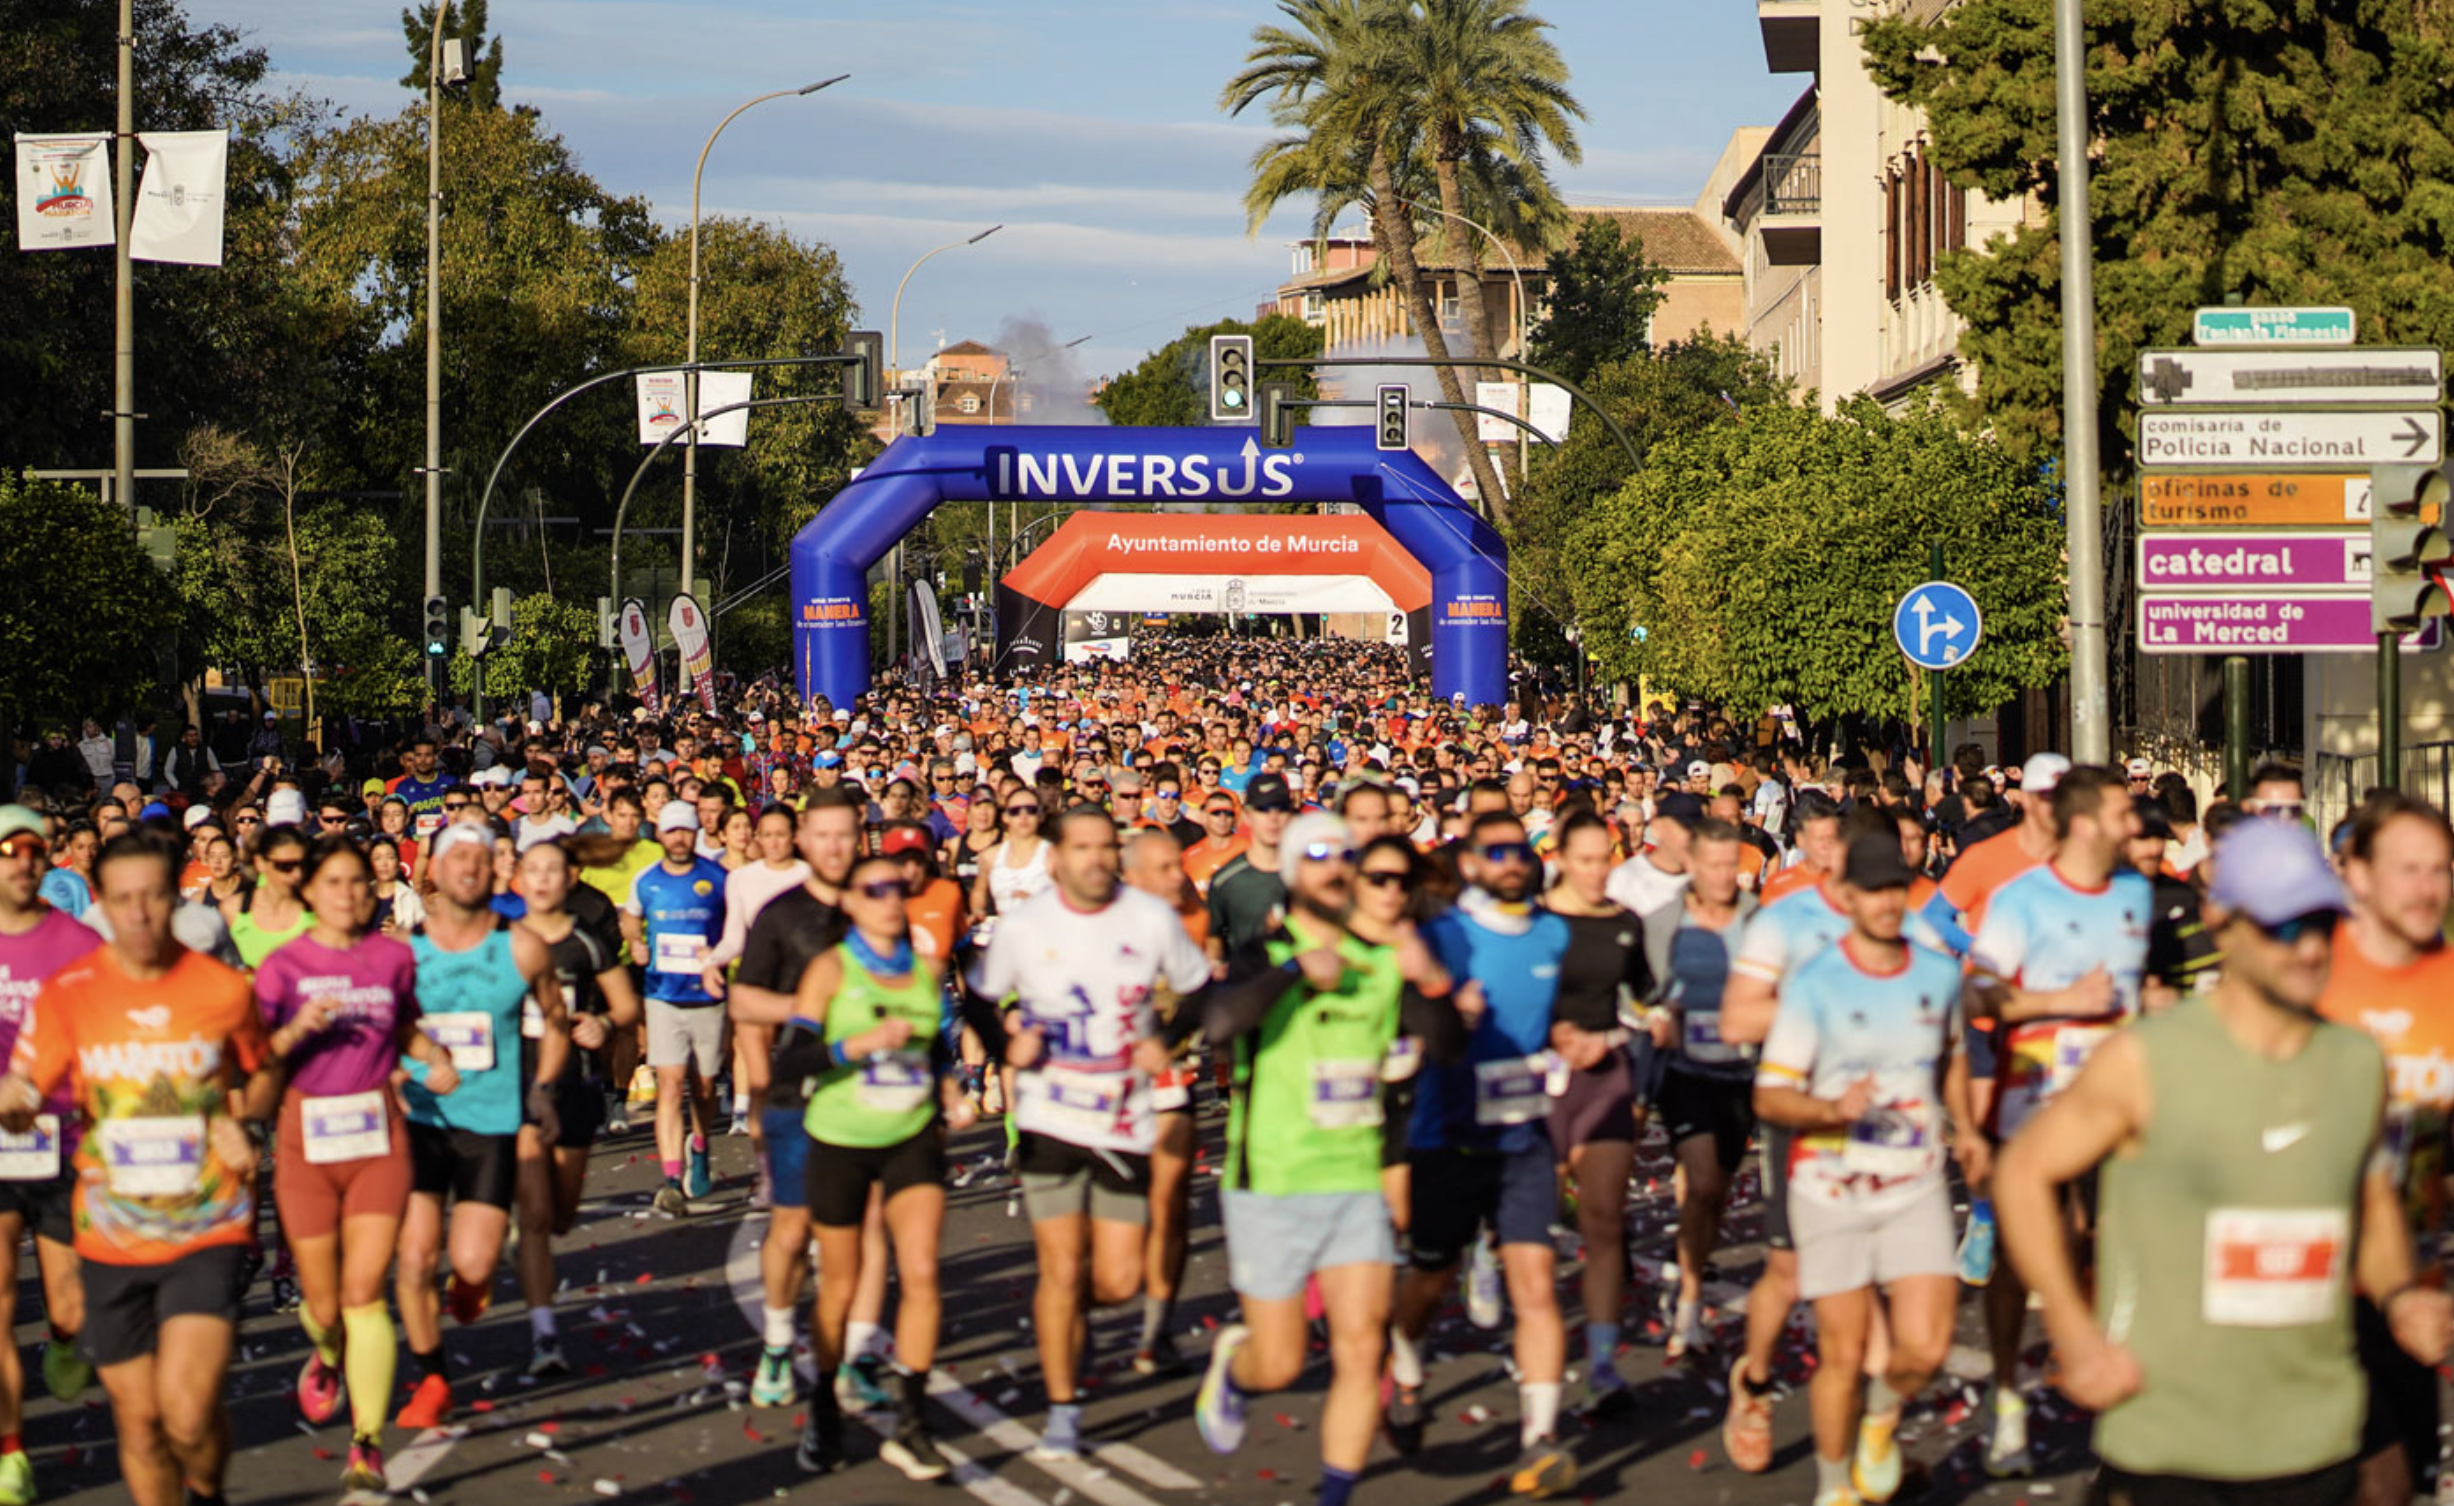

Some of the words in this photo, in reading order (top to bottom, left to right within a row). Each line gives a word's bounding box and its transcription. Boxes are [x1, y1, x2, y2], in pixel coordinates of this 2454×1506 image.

[2147, 418, 2244, 433] comisaria
[2259, 417, 2282, 433] de
[2250, 436, 2365, 456] Nacional
[2148, 478, 2250, 498] oficinas
[2268, 479, 2298, 497] de
[2149, 501, 2248, 520] turismo
[1107, 534, 1251, 554] Ayuntamiento
[1256, 535, 1281, 552] de
[1287, 535, 1359, 552] Murcia
[2149, 547, 2294, 575] catedral
[2149, 602, 2267, 620] universidad
[2278, 602, 2304, 620] de
[1391, 613, 1404, 636] 2
[2149, 622, 2178, 642] La
[2194, 622, 2288, 642] Merced
